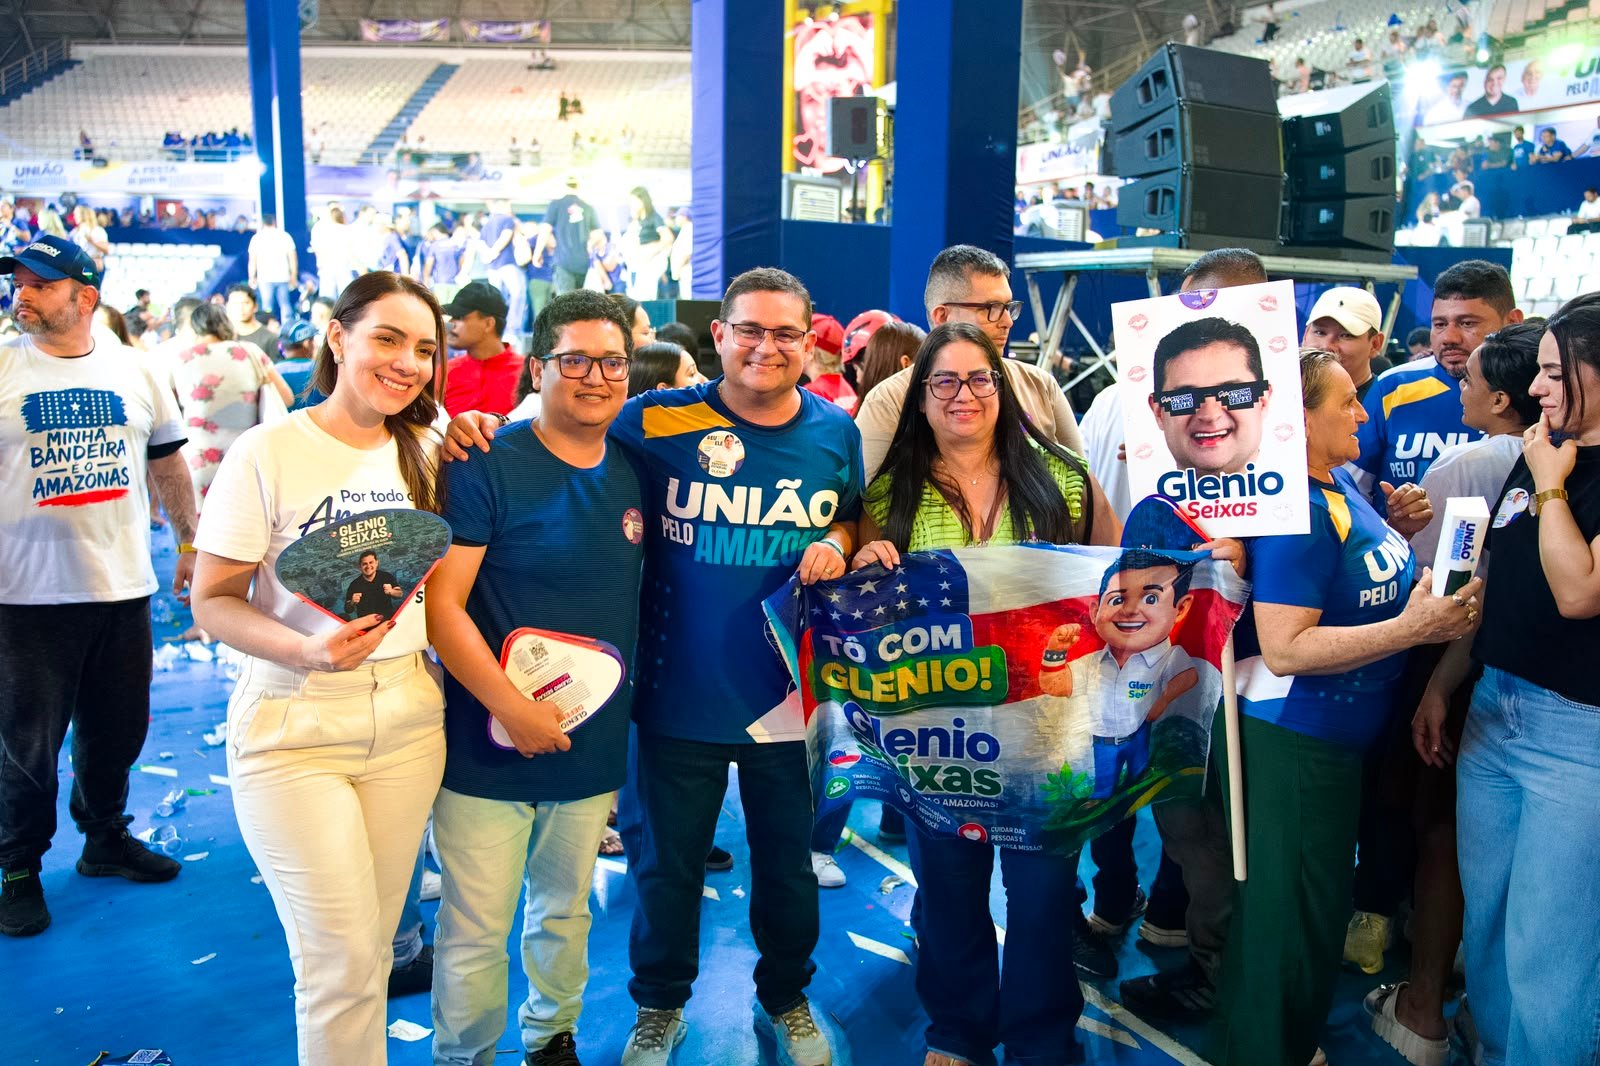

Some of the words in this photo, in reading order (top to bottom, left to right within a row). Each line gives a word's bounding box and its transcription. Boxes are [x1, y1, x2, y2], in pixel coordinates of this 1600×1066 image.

[14, 165, 64, 177] UNIÃO
[47, 428, 106, 447] MINHA
[30, 439, 126, 468] BANDEIRA
[84, 462, 93, 472] O
[1389, 461, 1415, 478] PELO
[32, 467, 130, 499] AMAZONAS
[1156, 463, 1284, 503] Glenio
[340, 489, 366, 503] Por
[370, 489, 404, 502] todo
[665, 477, 839, 528] UNIÃO
[1187, 499, 1257, 520] Seixas
[339, 515, 387, 537] GLENIO
[340, 526, 388, 548] SEIXAS
[661, 515, 694, 546] PELO
[1461, 523, 1476, 560] UNIÃO
[1359, 580, 1398, 608] PELO
[821, 635, 867, 664] TÔ
[878, 624, 963, 662] COM
[820, 656, 993, 703] GLENIO!
[560, 710, 588, 729] GLENIO
[843, 701, 1001, 763] Glenio
[942, 798, 999, 809] AMAZONAS:
[991, 834, 1018, 842] PESSOAS
[1014, 827, 1026, 835] DAS
